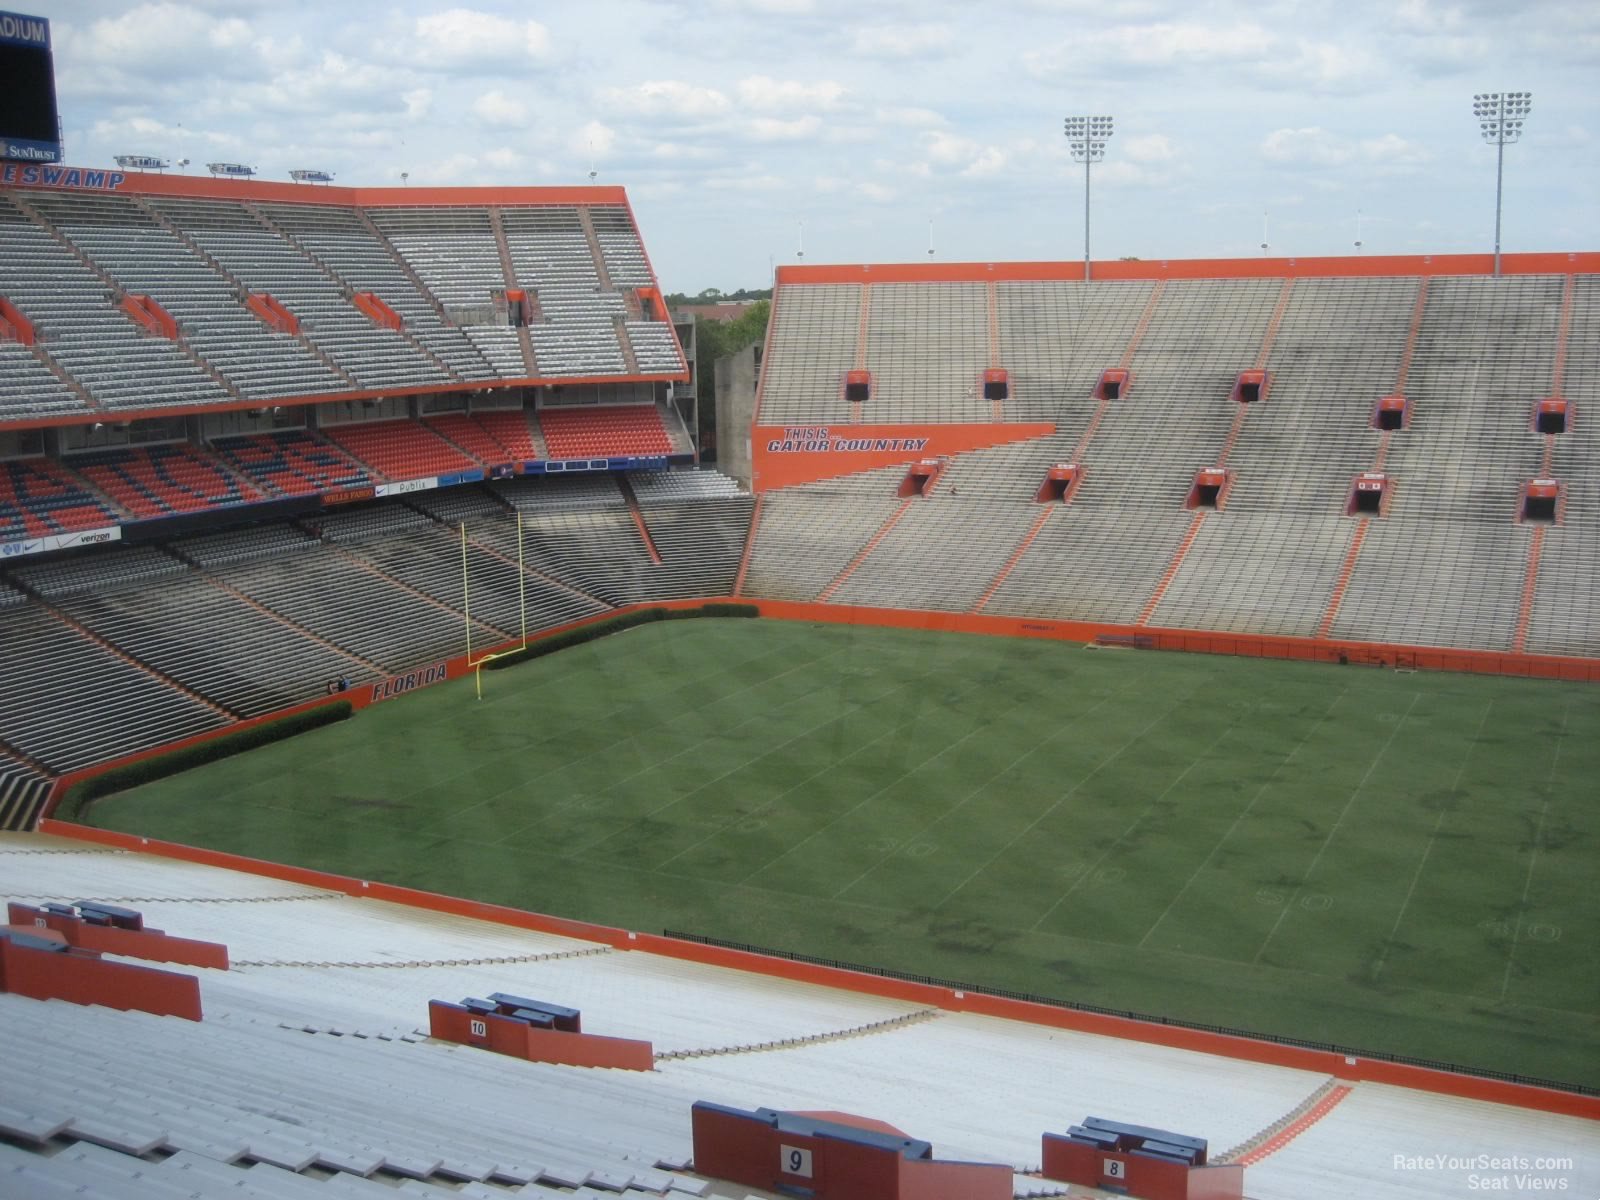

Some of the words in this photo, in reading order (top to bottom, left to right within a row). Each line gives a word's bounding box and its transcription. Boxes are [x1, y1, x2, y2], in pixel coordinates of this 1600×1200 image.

[23, 167, 125, 189] SWAMP
[783, 428, 814, 440] THIS
[767, 439, 830, 452] GATOR
[834, 438, 928, 452] COUNTRY
[399, 480, 426, 492] Publix
[324, 491, 350, 504] WELLS
[80, 532, 111, 543] verizon
[372, 664, 446, 701] FLORIDA
[473, 1023, 484, 1035] 10
[790, 1150, 802, 1172] 9
[1110, 1163, 1119, 1175] 8
